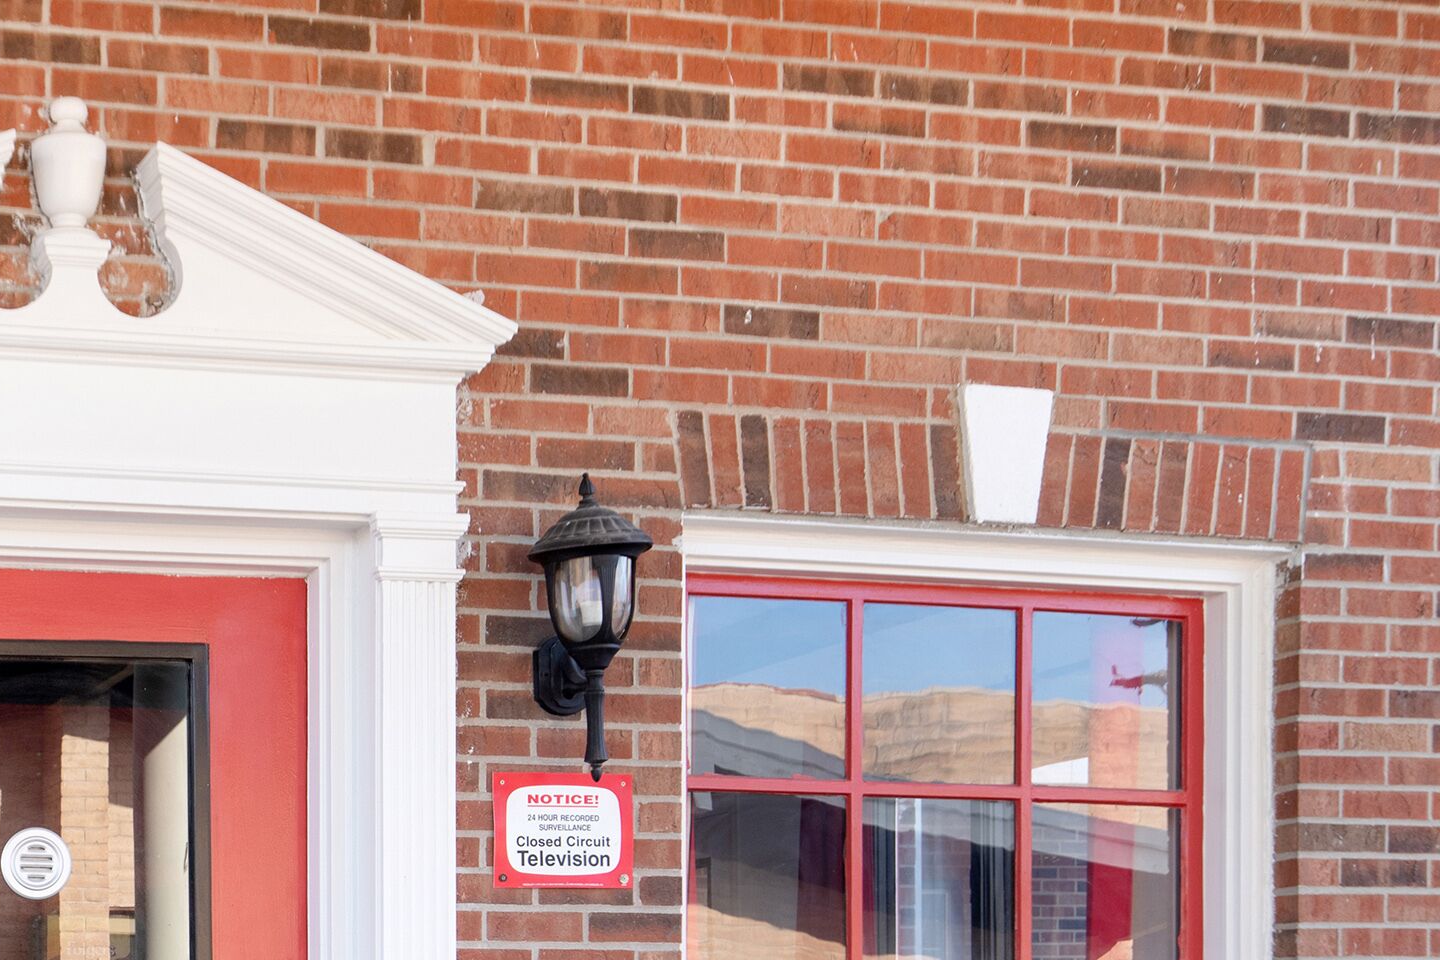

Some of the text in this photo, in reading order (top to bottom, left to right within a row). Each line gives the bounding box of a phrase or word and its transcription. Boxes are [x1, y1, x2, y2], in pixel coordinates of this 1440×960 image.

[527, 794, 599, 805] NOTICE!
[527, 814, 600, 823] 24 HOUR RECORDED
[538, 824, 592, 832] SURVEILLANCE
[516, 835, 611, 848] Closed Circuit
[517, 850, 611, 867] Television
